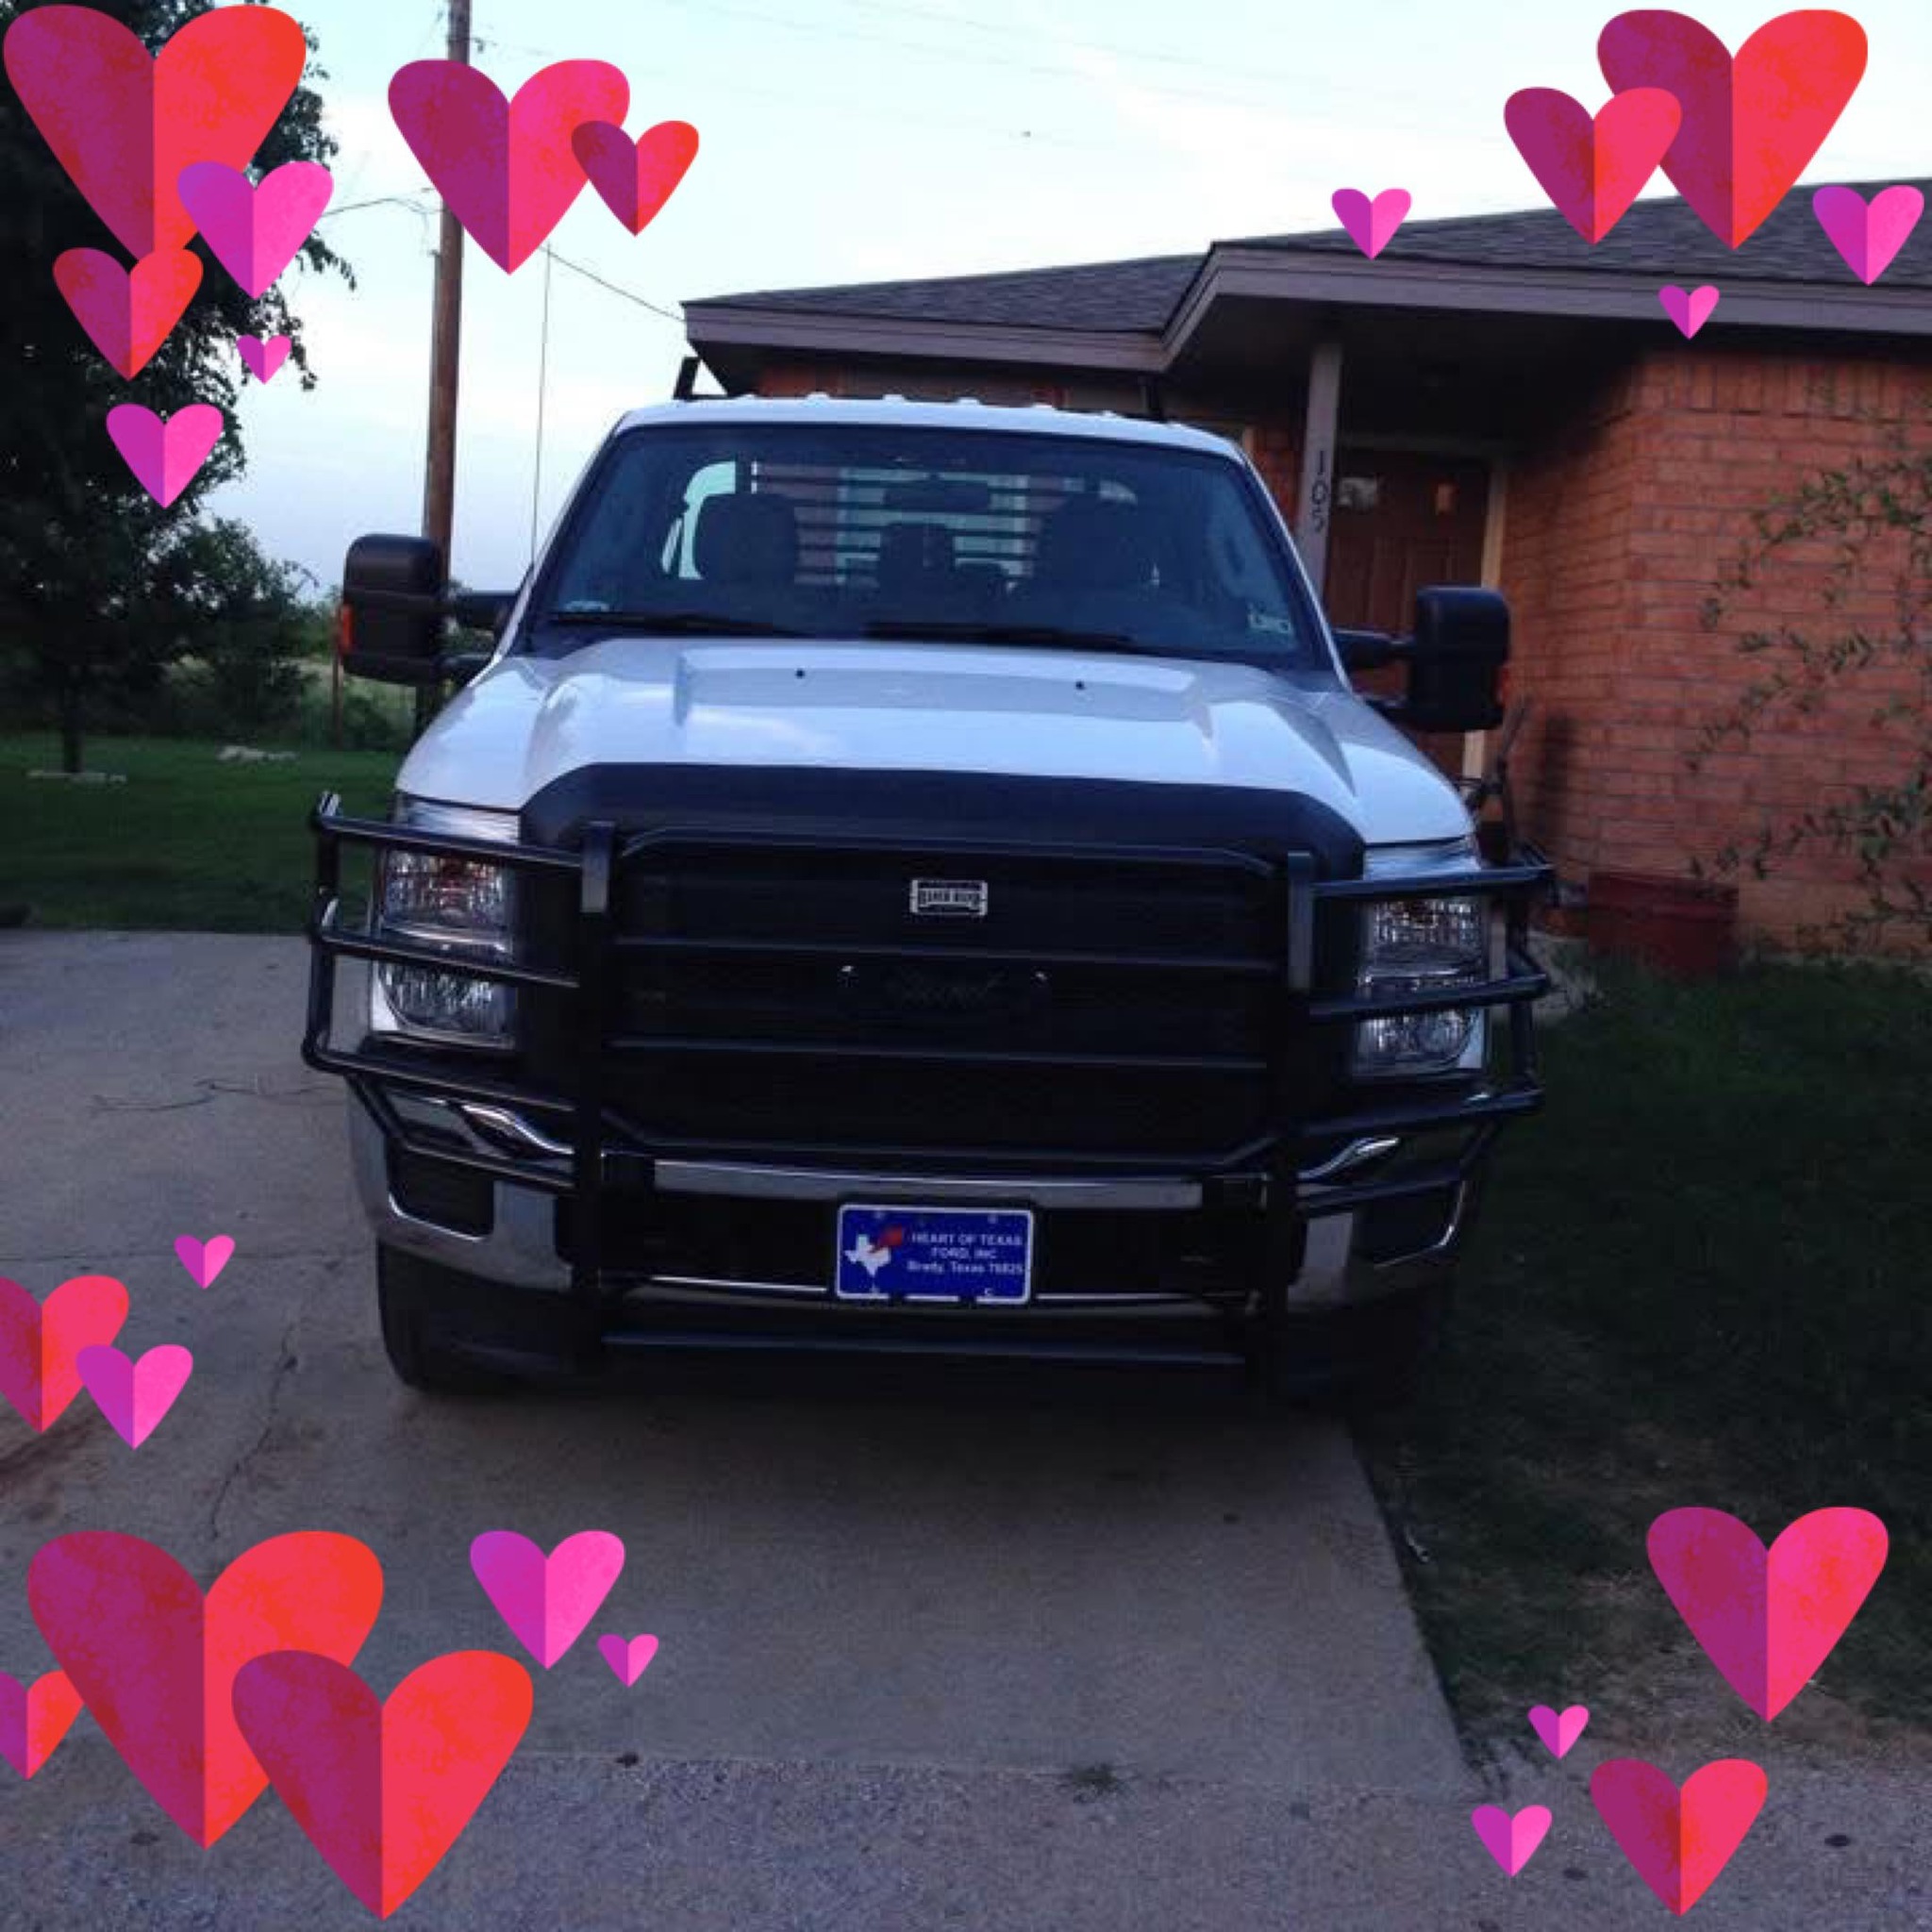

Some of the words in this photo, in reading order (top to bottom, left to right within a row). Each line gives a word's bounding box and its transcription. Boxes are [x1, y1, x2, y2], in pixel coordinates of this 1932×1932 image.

[1311, 450, 1328, 533] 105
[911, 1232, 954, 1244] HEART
[957, 1233, 975, 1245] OF
[978, 1233, 1023, 1246] TEXAS
[949, 1260, 986, 1274] Texas
